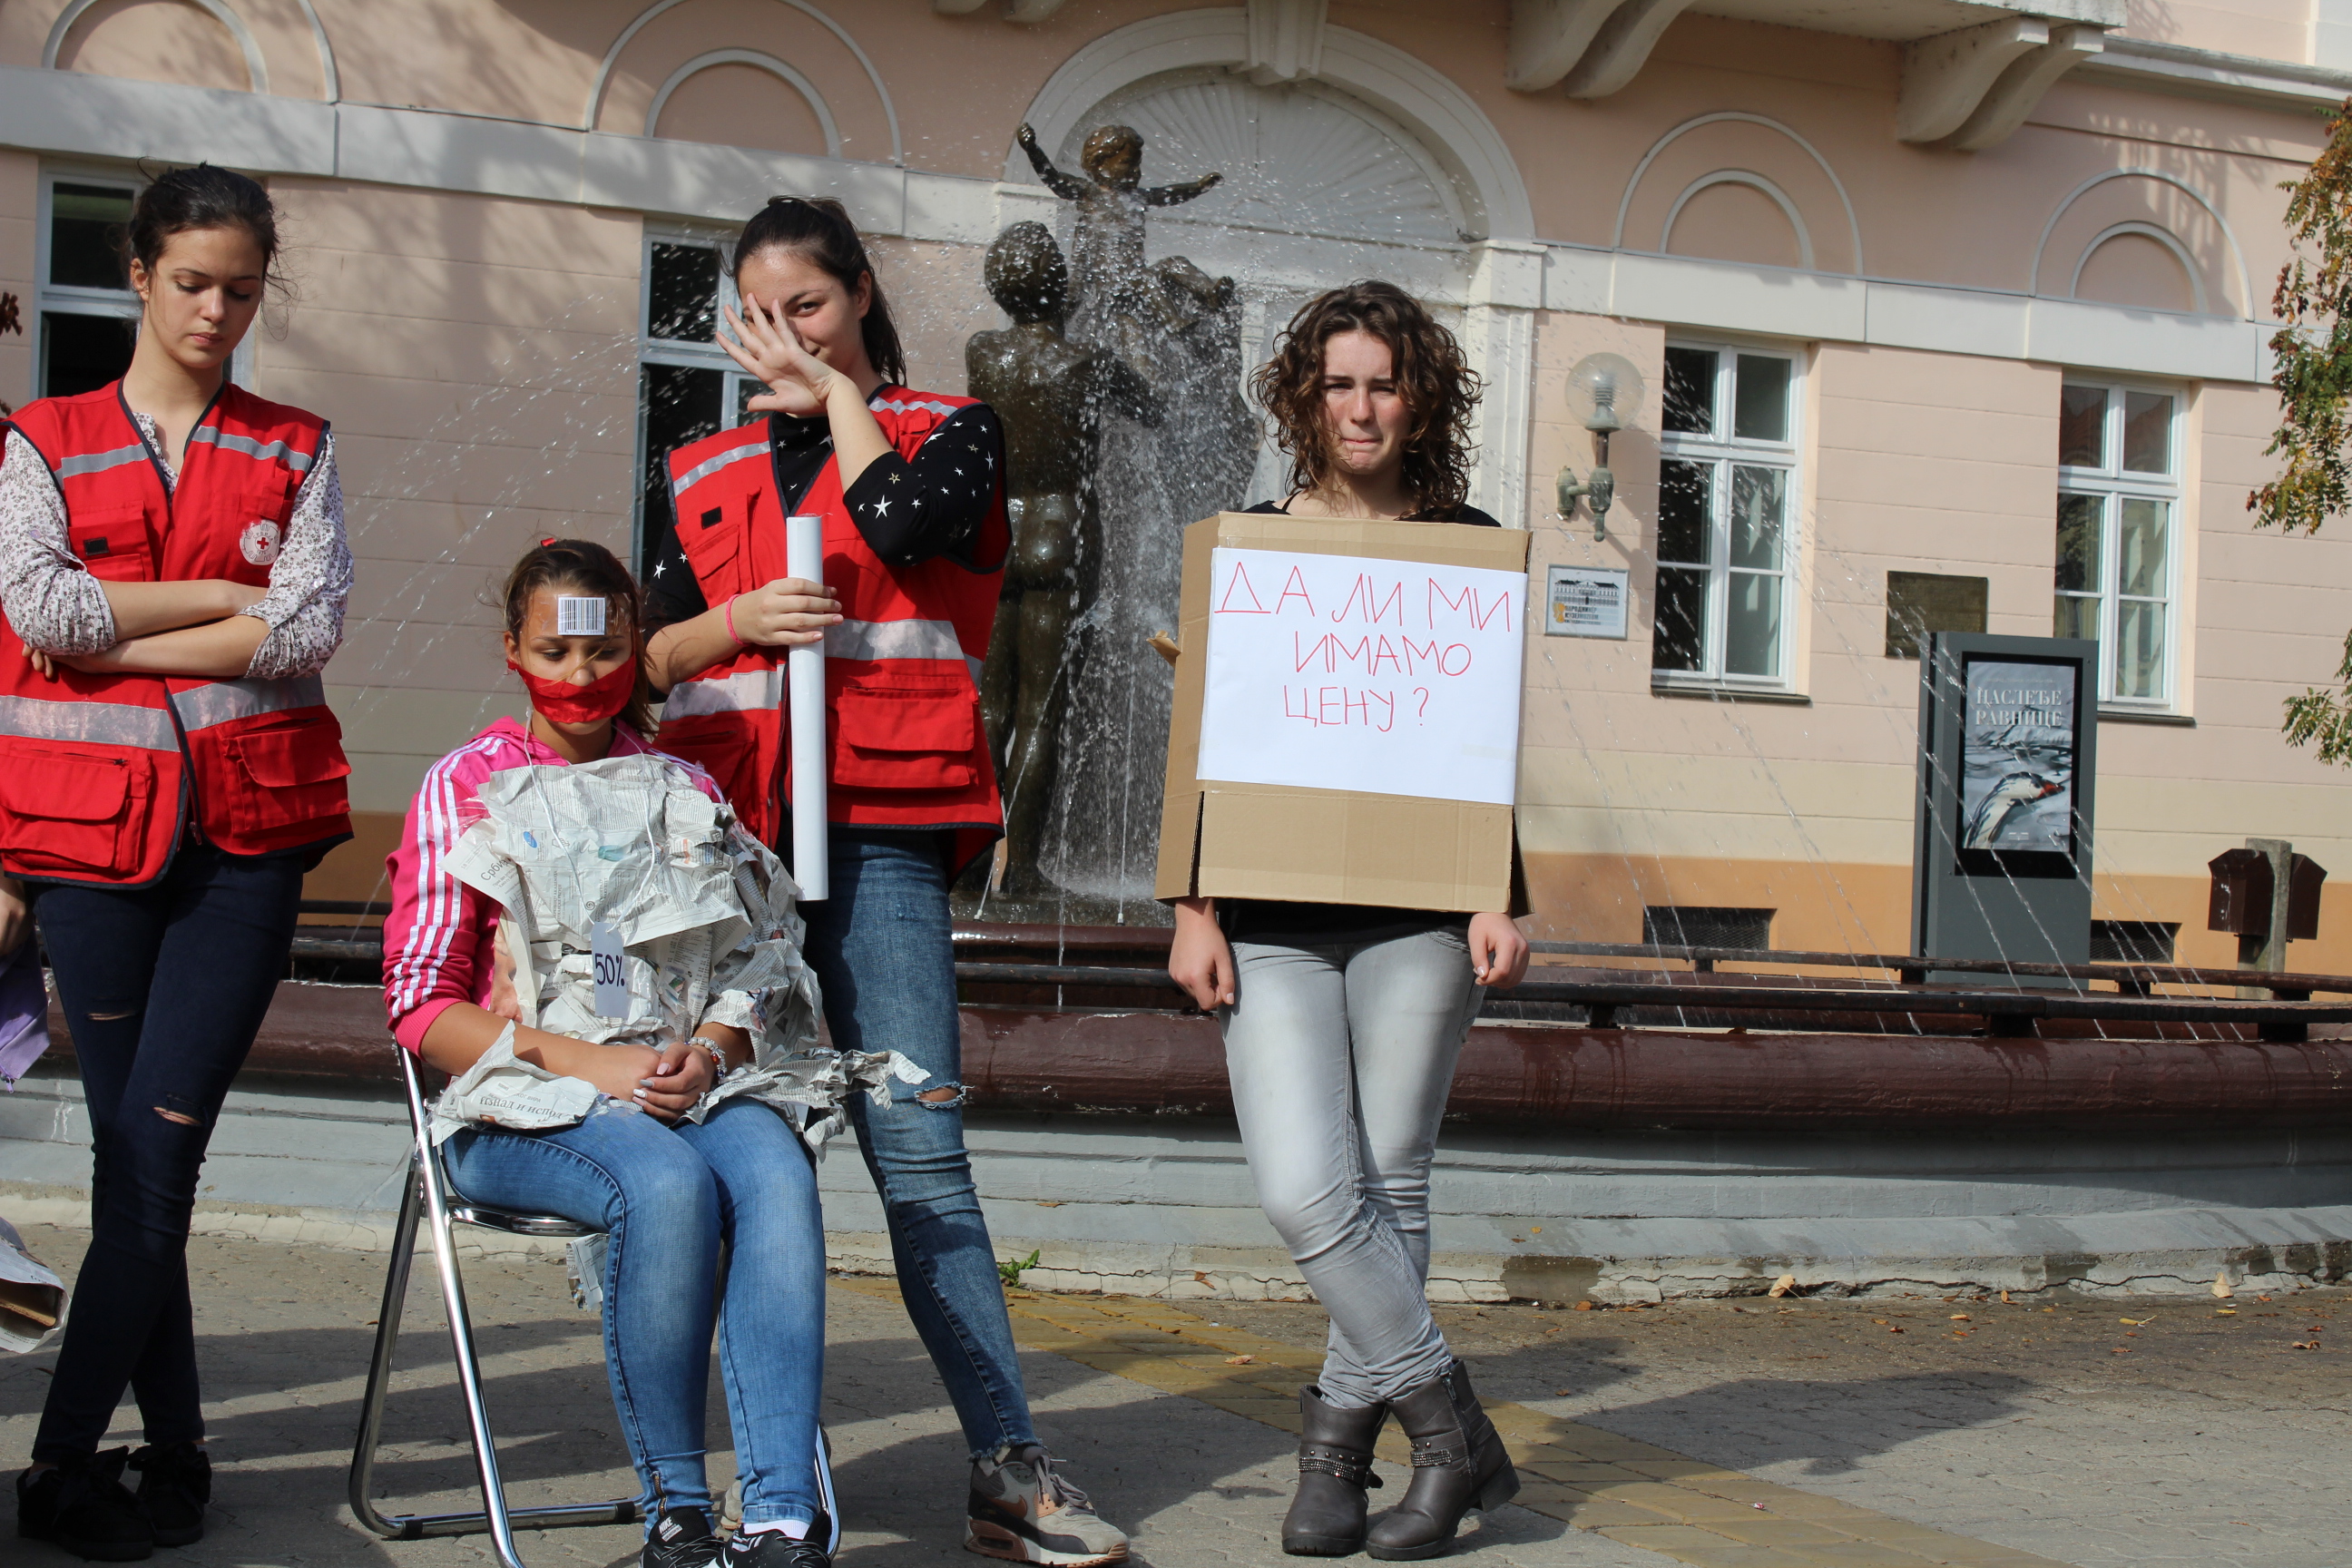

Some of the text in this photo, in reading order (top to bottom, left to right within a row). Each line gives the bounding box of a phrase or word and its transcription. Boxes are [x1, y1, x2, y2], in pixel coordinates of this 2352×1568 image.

[1214, 561, 1511, 632] ДА ЛИ МИ
[1295, 631, 1472, 676] ИМАМО
[1976, 688, 2062, 705] НАСЛЕЂЕ
[1975, 710, 2063, 729] РАВНИЦЕ
[594, 953, 625, 987] 50%
